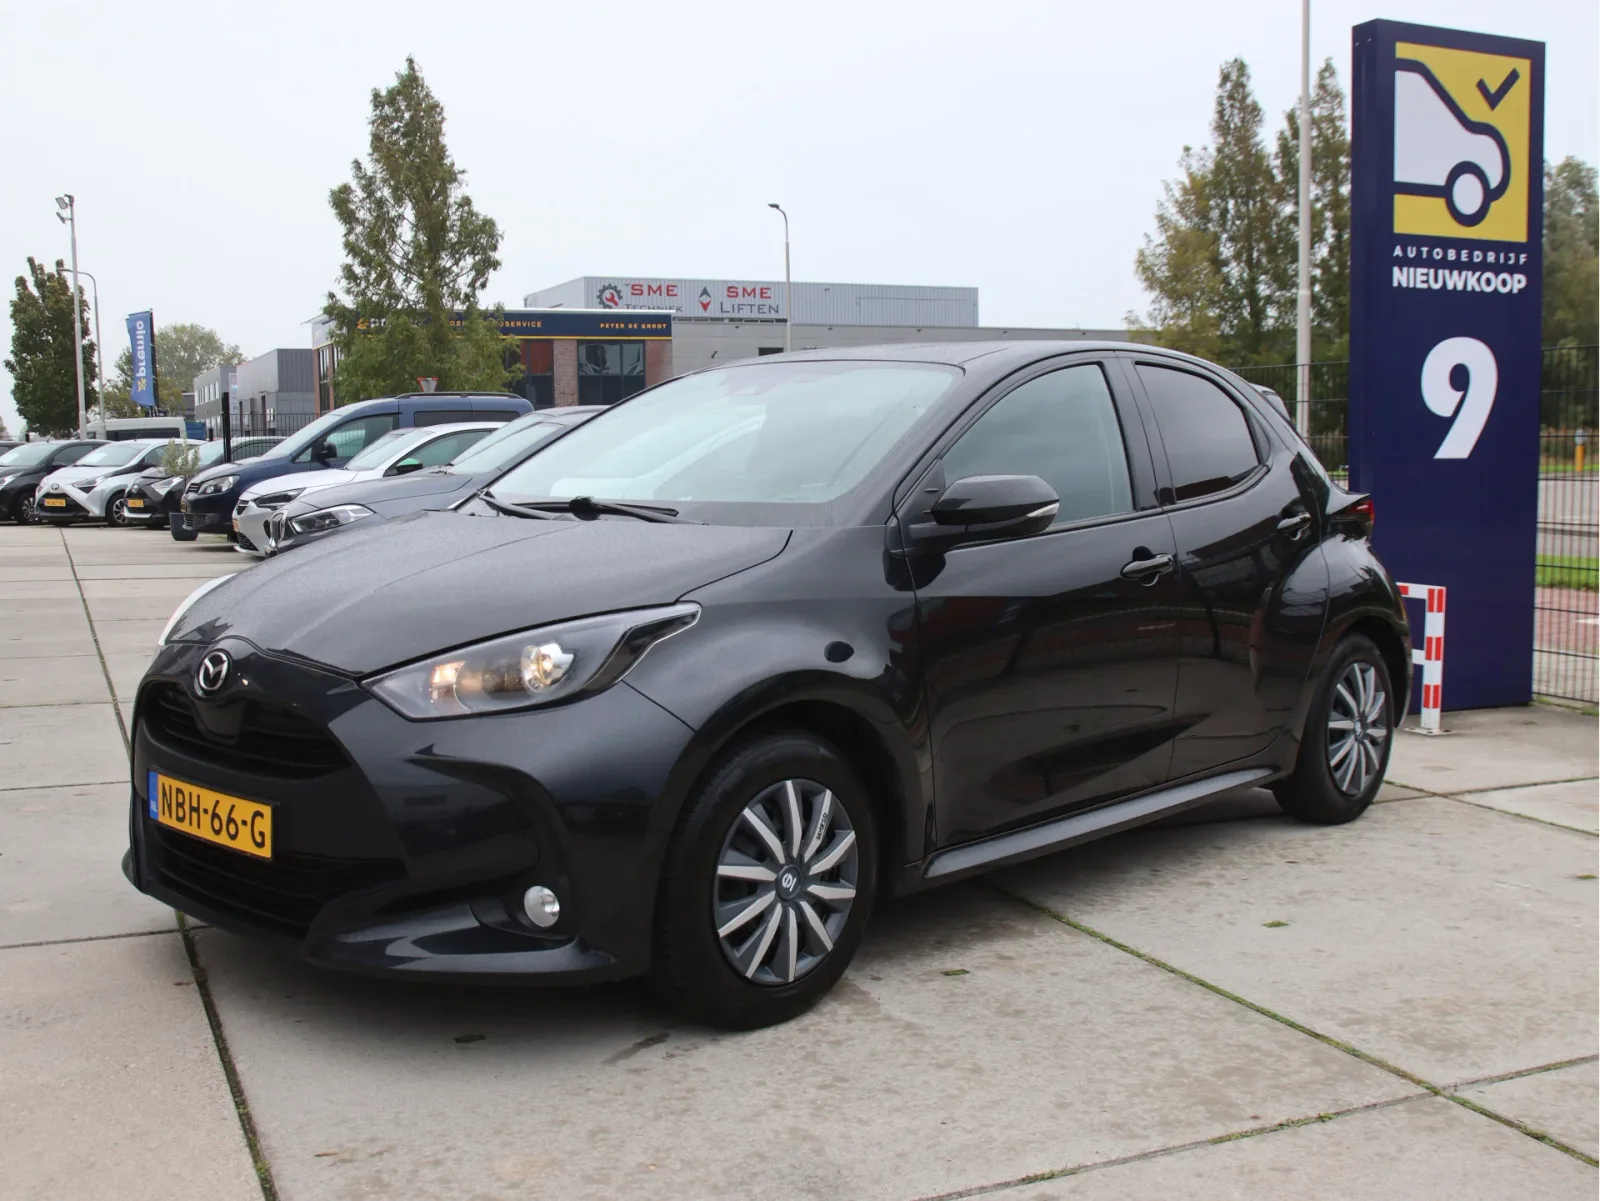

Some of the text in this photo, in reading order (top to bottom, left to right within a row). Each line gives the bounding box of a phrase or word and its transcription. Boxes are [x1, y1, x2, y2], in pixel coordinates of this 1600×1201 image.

[1392, 244, 1528, 266] AUTOBEDRIJF
[630, 283, 678, 297] SME
[1392, 265, 1527, 294] NIEUWKOOP
[726, 285, 772, 299] SME
[720, 301, 779, 314] LIFTEN
[1421, 336, 1498, 460] 9
[161, 781, 266, 849] NBH-66-G
